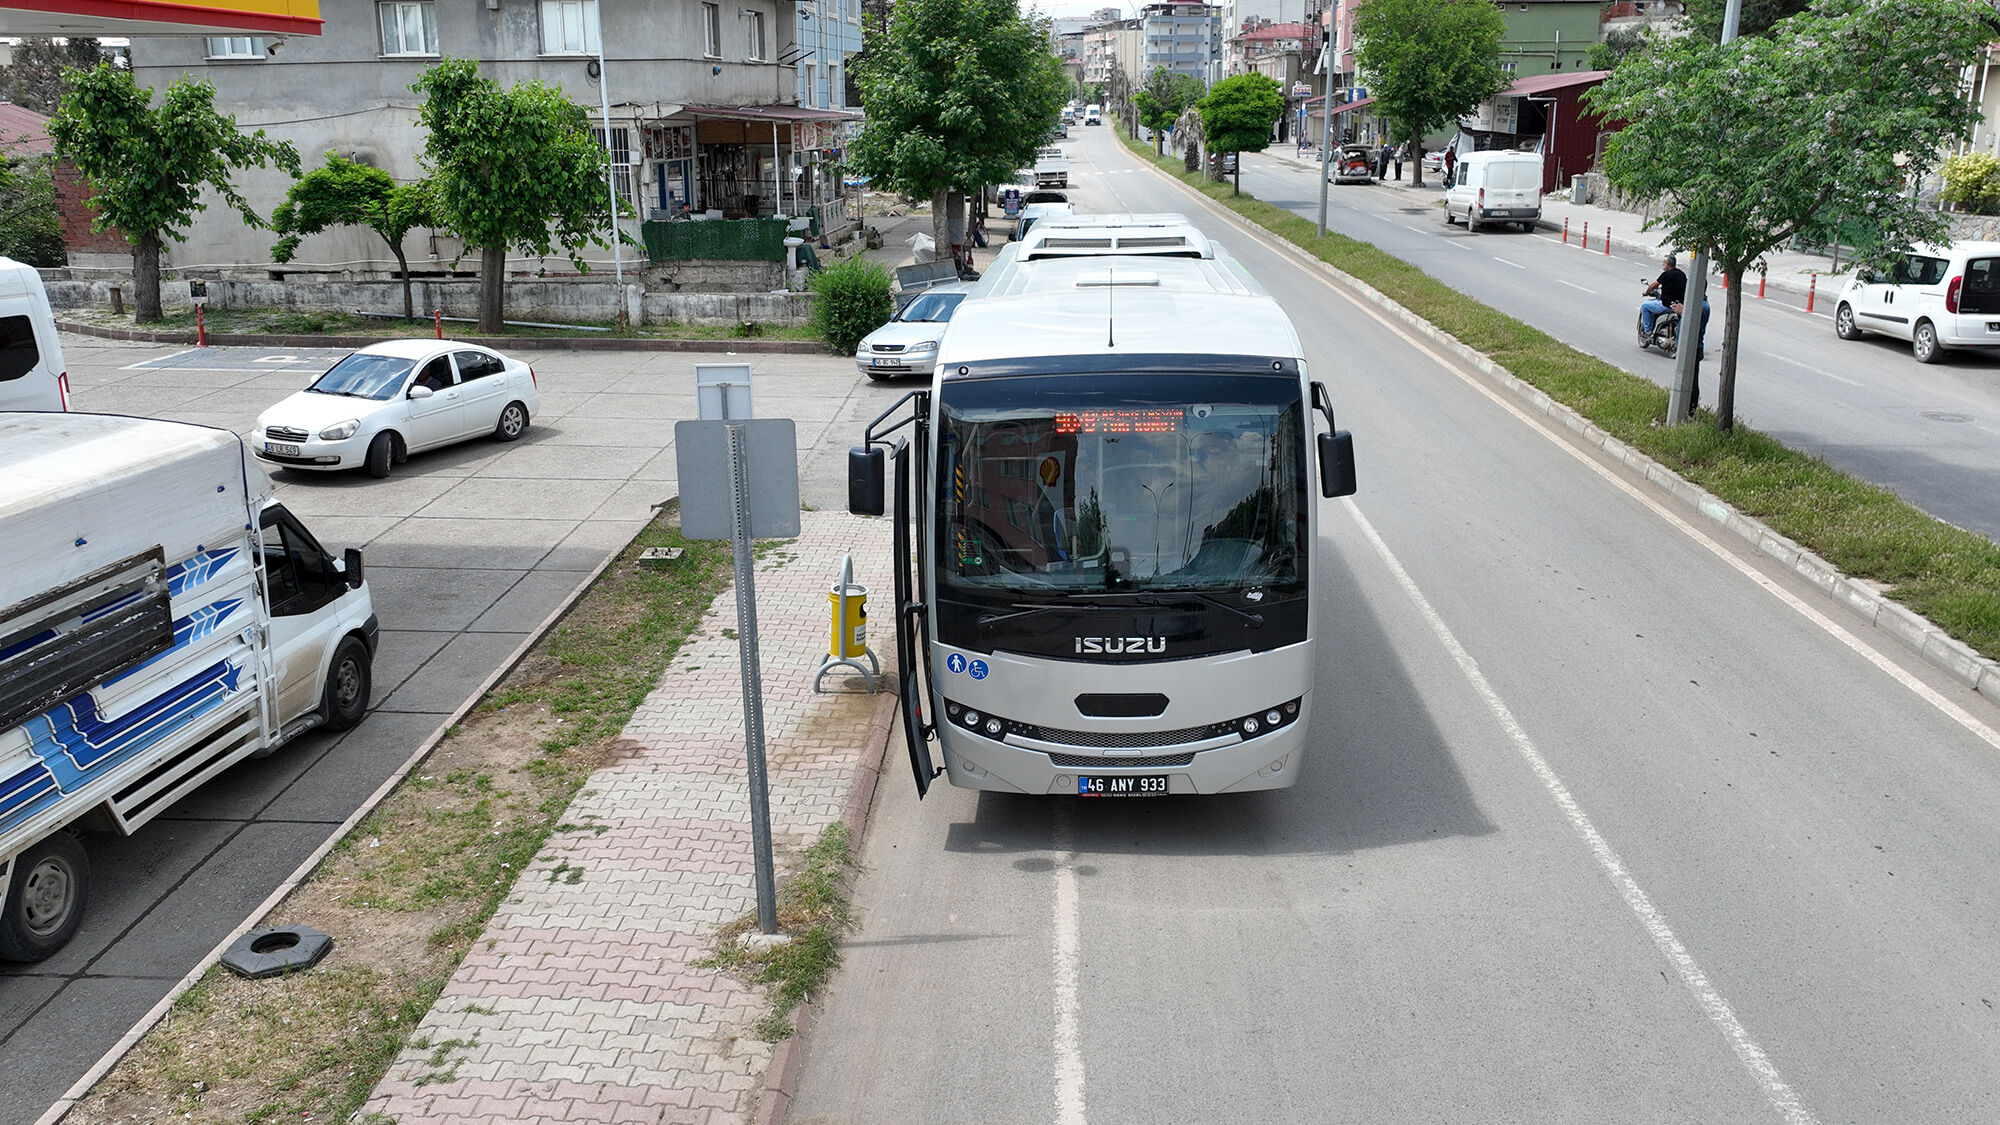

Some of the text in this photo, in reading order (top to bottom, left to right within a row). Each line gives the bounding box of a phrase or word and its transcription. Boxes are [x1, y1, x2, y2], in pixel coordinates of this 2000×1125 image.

[1075, 637, 1166, 653] ISUZU
[1087, 778, 1166, 791] 46 ANY 933
